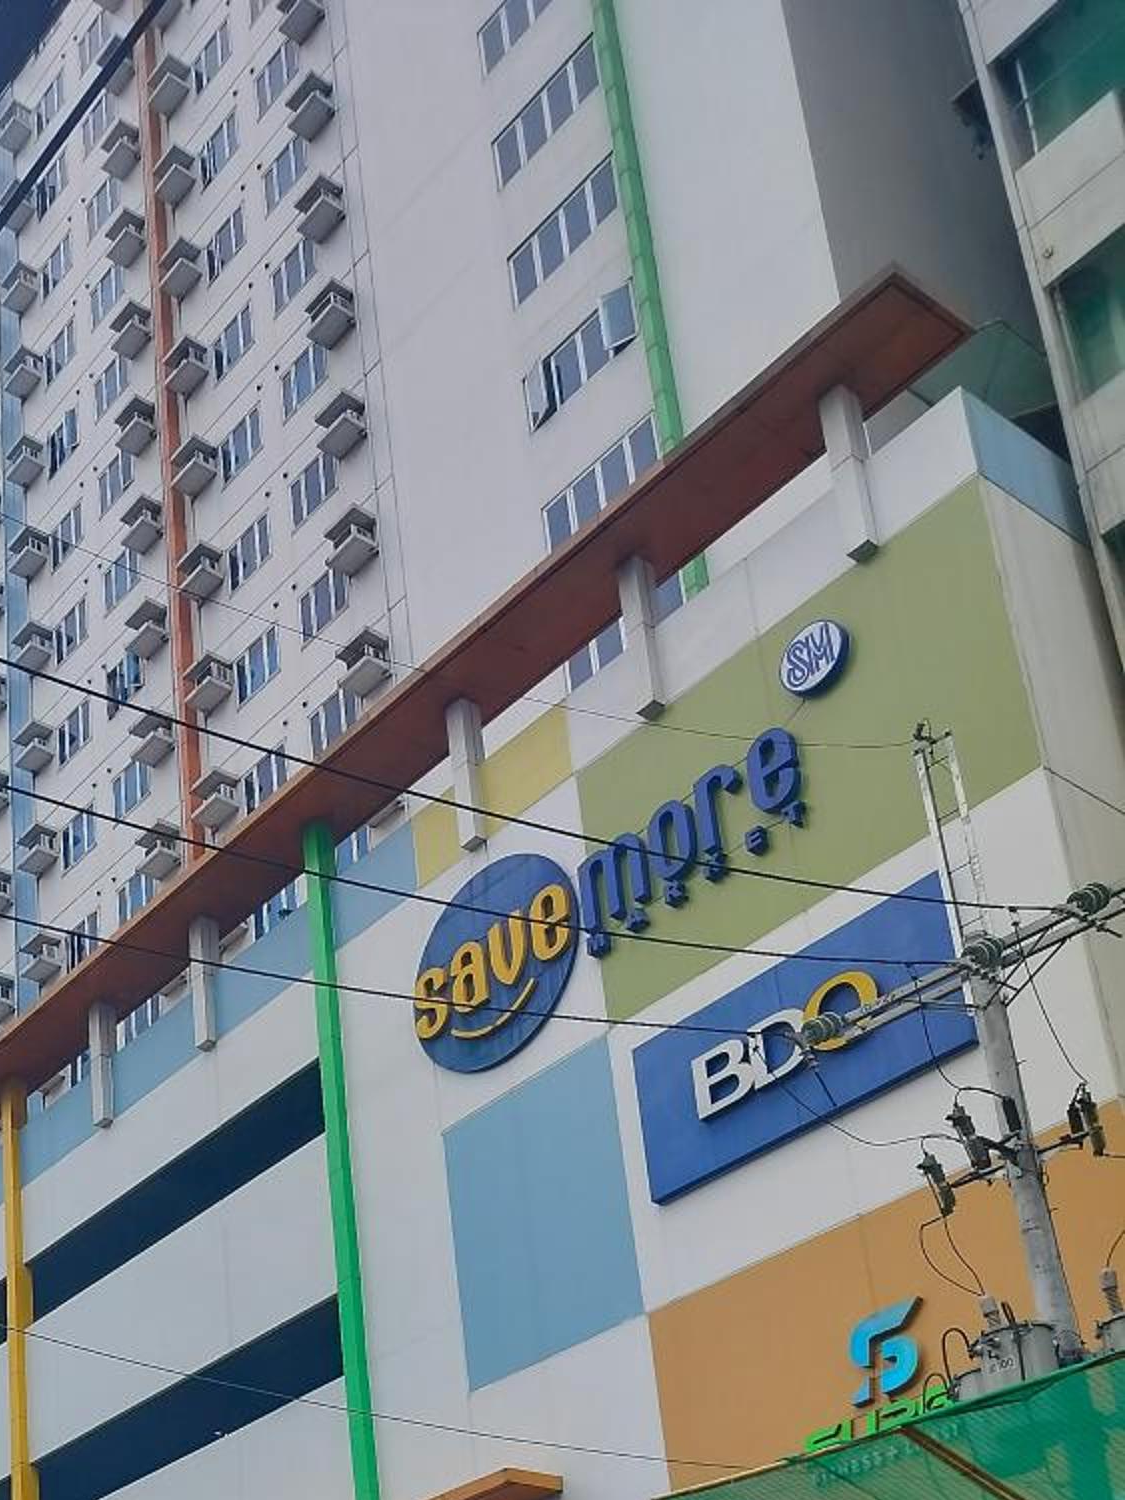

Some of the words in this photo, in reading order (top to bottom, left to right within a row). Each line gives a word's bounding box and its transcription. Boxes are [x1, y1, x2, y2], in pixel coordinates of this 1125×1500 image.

[786, 622, 836, 688] SM
[415, 884, 571, 1038] save
[577, 728, 802, 935] more
[691, 971, 878, 1119] BDO
